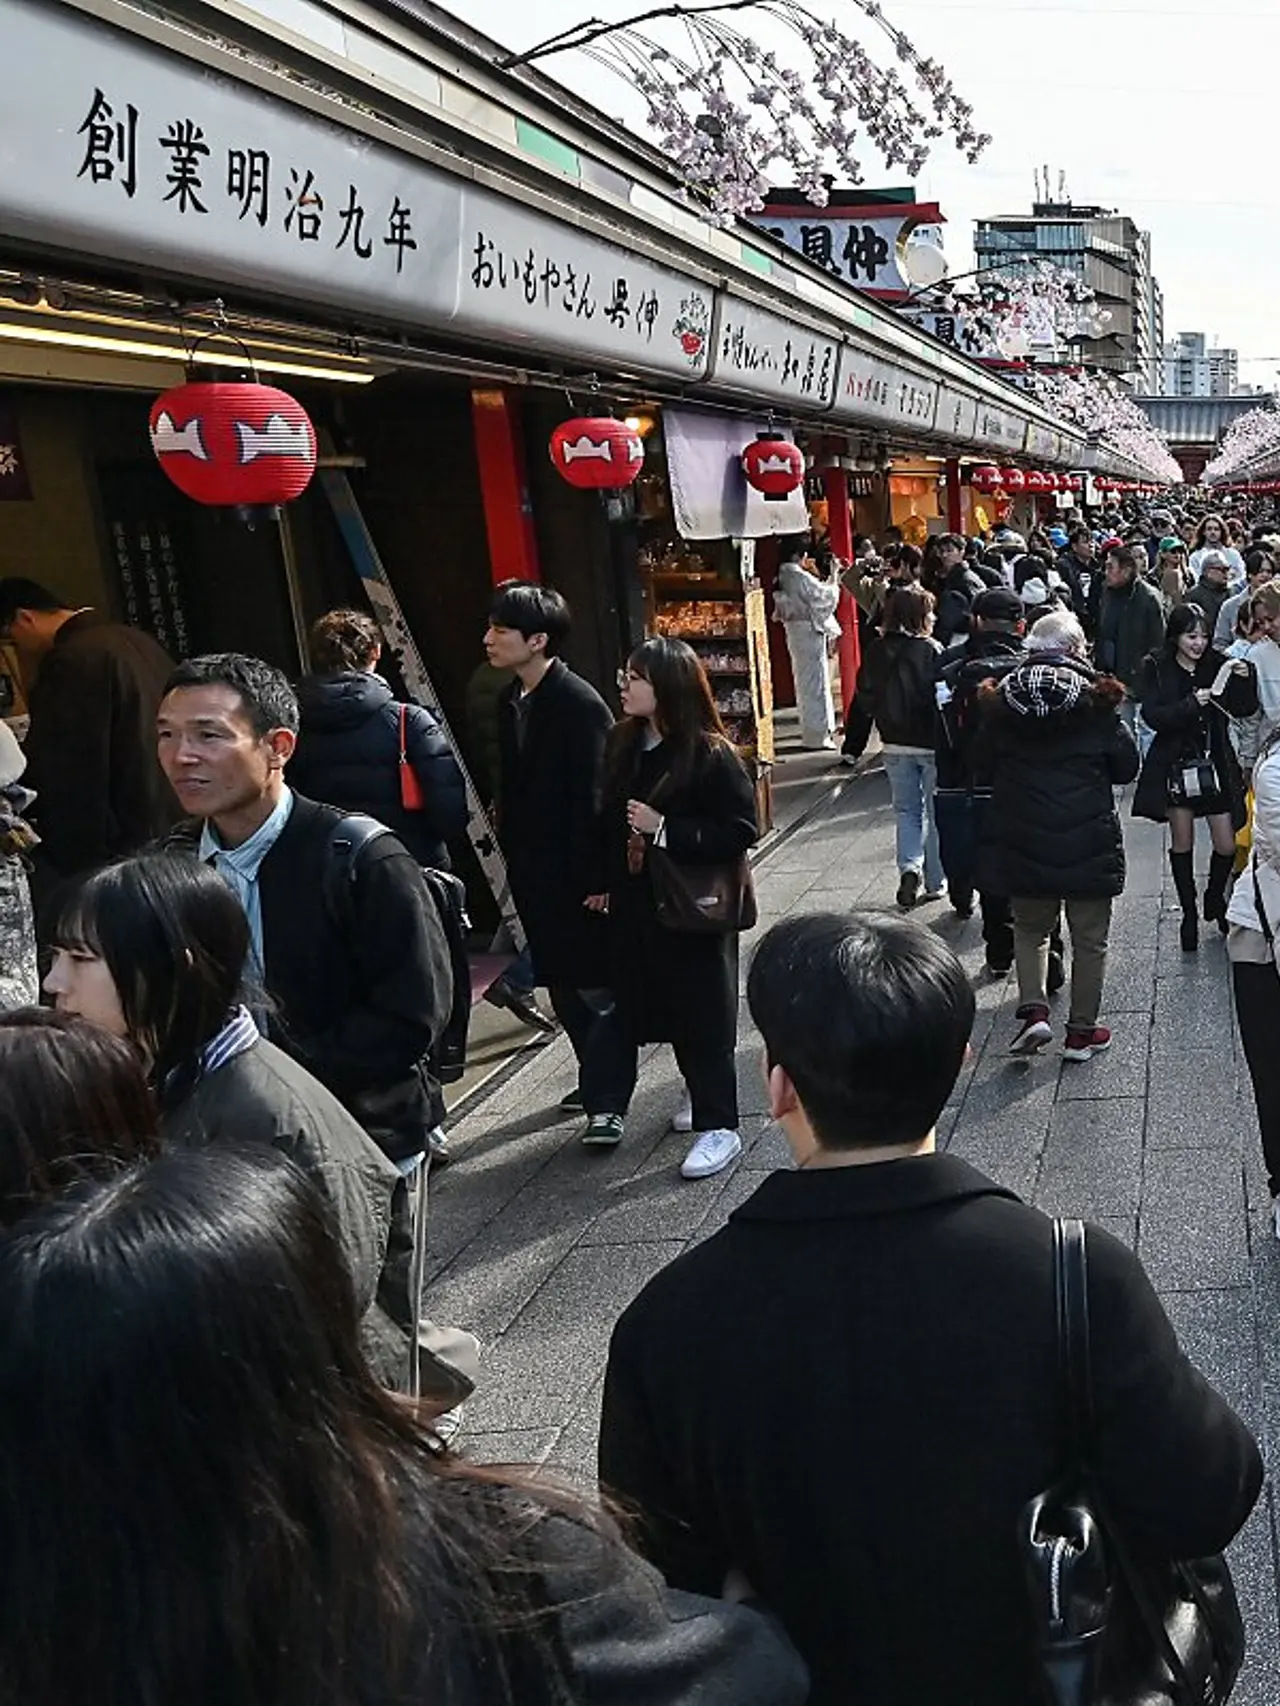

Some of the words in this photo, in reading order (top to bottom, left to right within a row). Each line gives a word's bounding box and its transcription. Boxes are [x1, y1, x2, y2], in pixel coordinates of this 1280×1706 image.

[76, 87, 418, 273] 創業明治九年
[471, 231, 597, 319] おいもやさん
